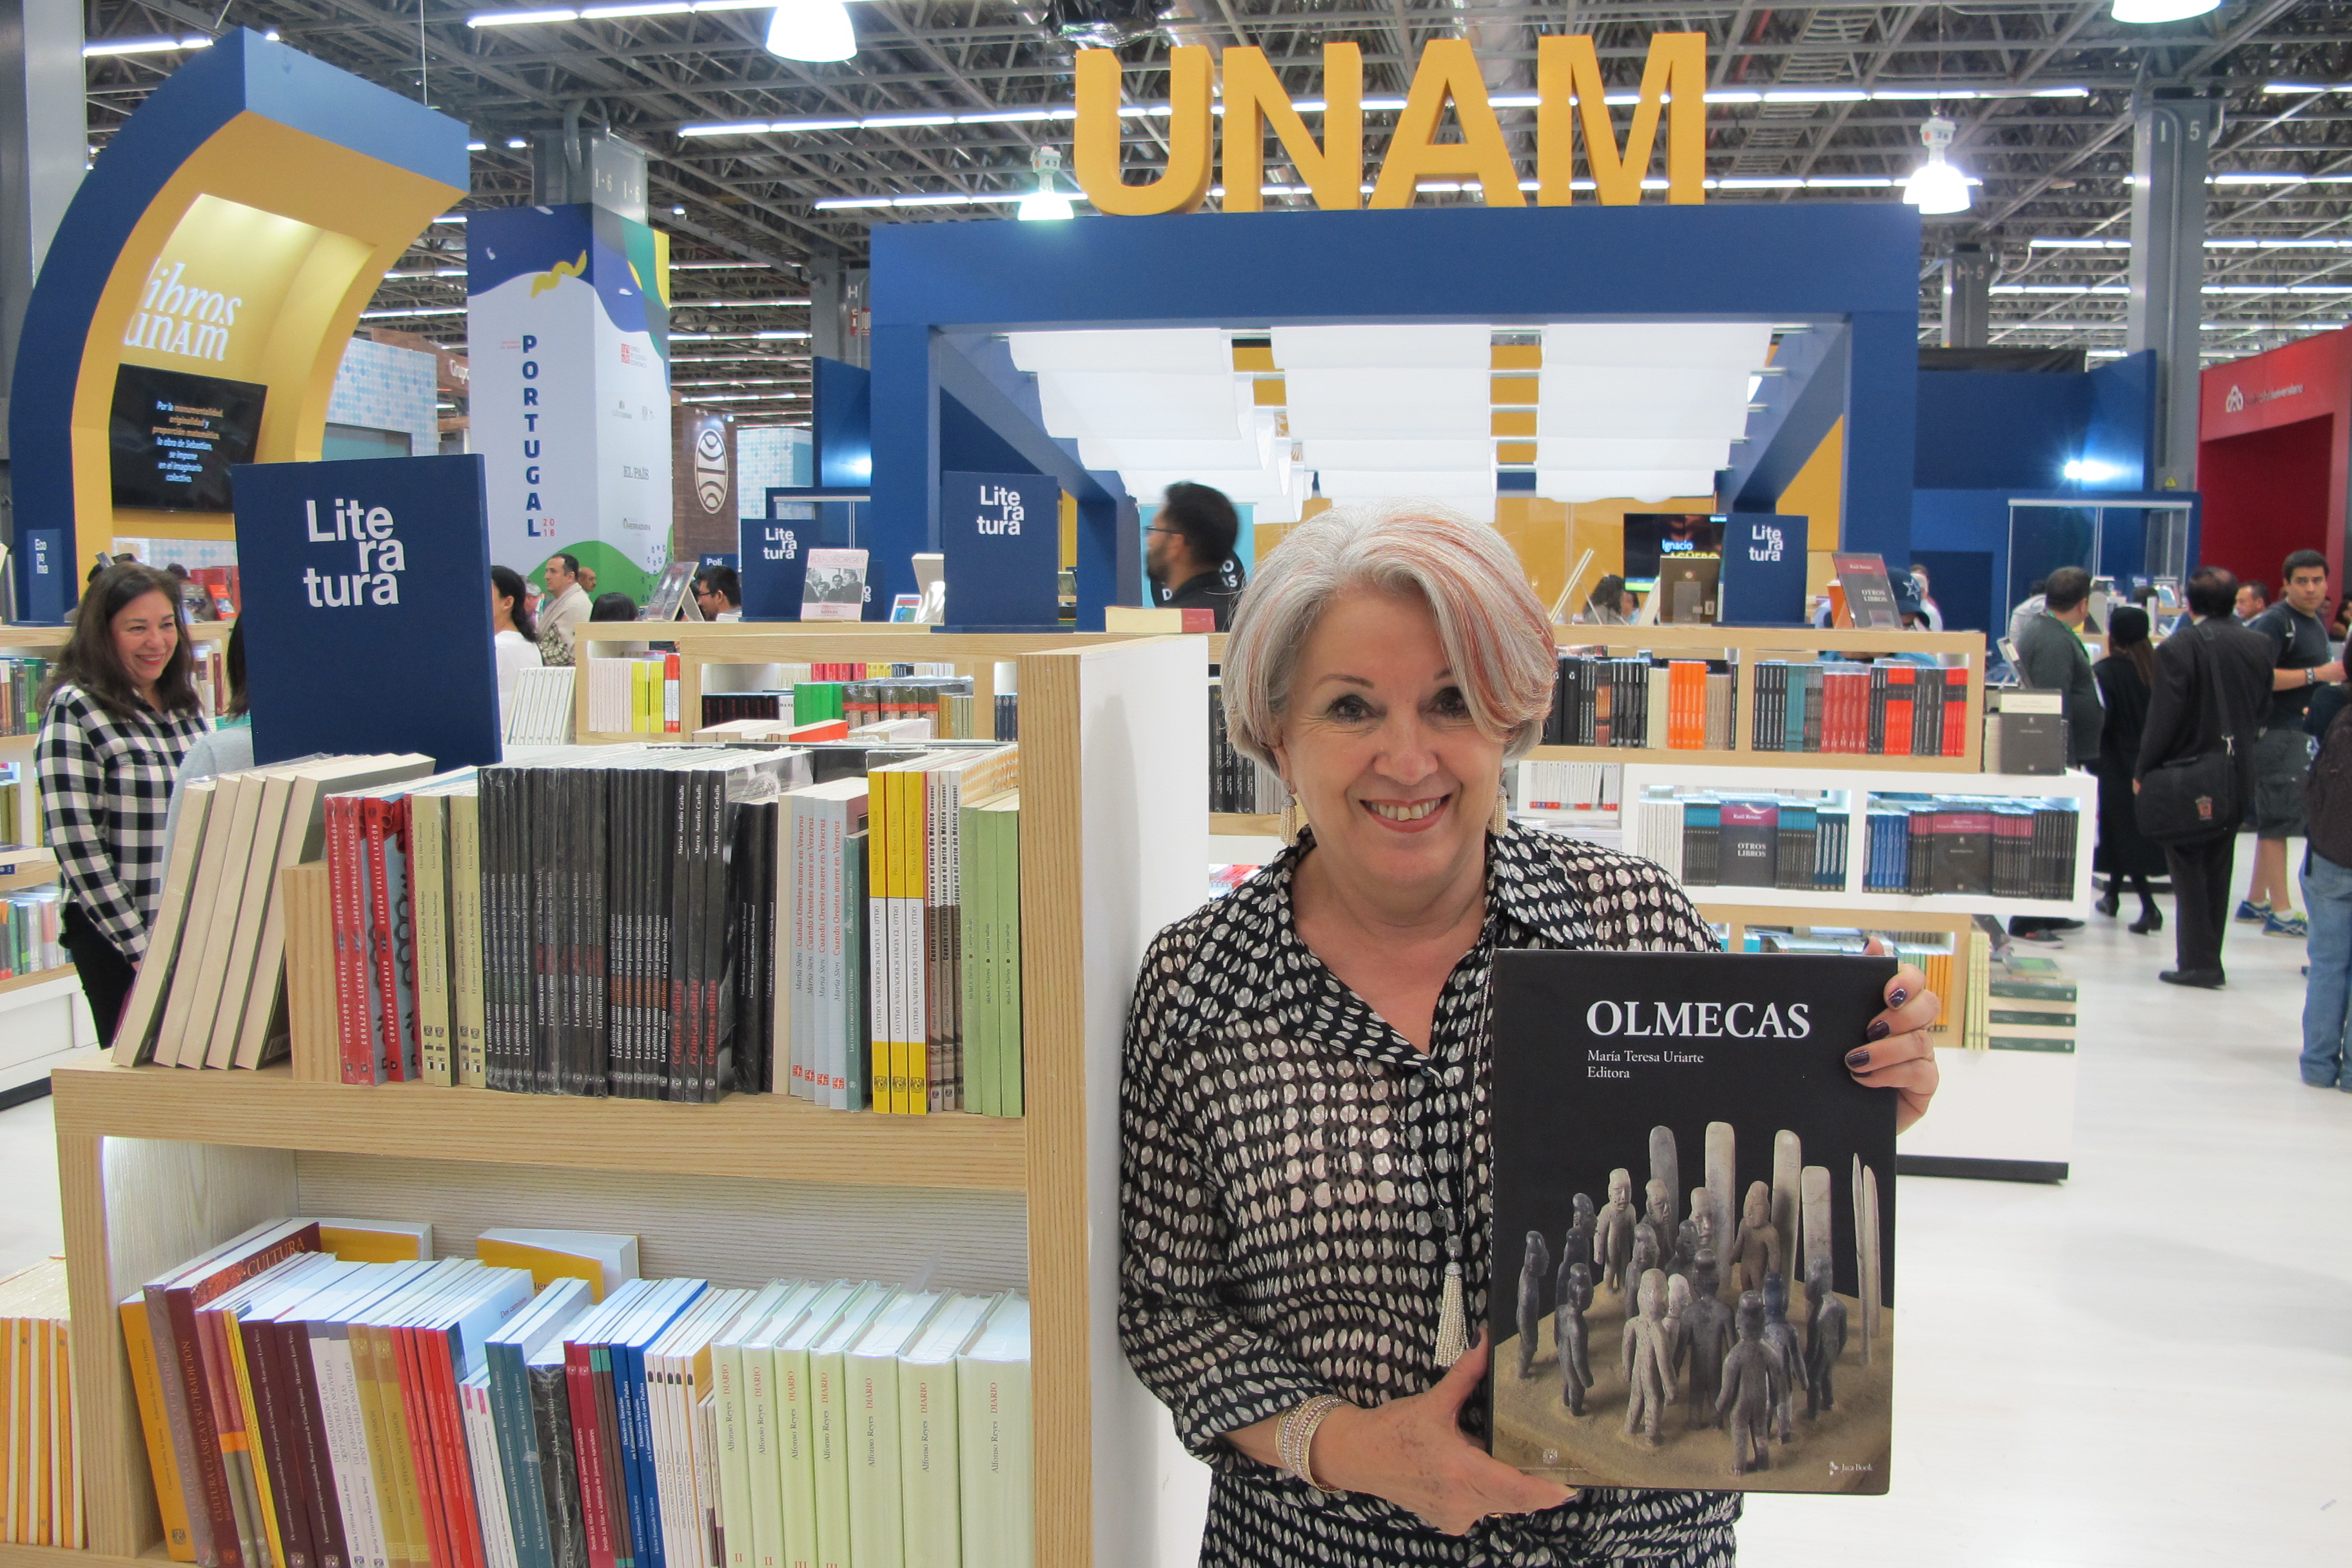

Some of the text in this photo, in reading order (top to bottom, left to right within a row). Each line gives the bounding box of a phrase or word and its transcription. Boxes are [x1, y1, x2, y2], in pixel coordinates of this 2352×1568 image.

[1074, 32, 1706, 216] UNAM
[144, 258, 242, 326] ibros
[522, 335, 542, 536] PORTUGAL
[981, 486, 1021, 506] Lite
[306, 498, 394, 542] Lite
[1003, 505, 1024, 522] ra
[765, 527, 794, 541] Lite
[977, 516, 1021, 535] tura
[1752, 525, 1781, 540] Lite
[763, 547, 795, 560] tura
[782, 540, 798, 550] ra
[1661, 539, 1694, 553] Ignacio
[1749, 547, 1781, 562] tura
[1769, 539, 1783, 551] ra
[358, 539, 406, 573] ra
[303, 568, 400, 607] tura
[819, 855, 825, 864] en
[1586, 1000, 1810, 1039] OLMECAS
[1587, 1050, 1704, 1063] María Teresa Uriarte
[1587, 1066, 1631, 1079] Editora
[248, 1237, 306, 1277] CULTURA
[721, 1364, 730, 1395] DIARIO
[753, 1366, 762, 1397] DIARIO
[787, 1371, 796, 1401] DIARIO
[726, 1402, 735, 1422] Reyes
[758, 1404, 766, 1425] Reyes
[867, 1416, 876, 1436] Reyes
[921, 1420, 930, 1442] Reyes
[991, 1420, 1000, 1442] Reyes
